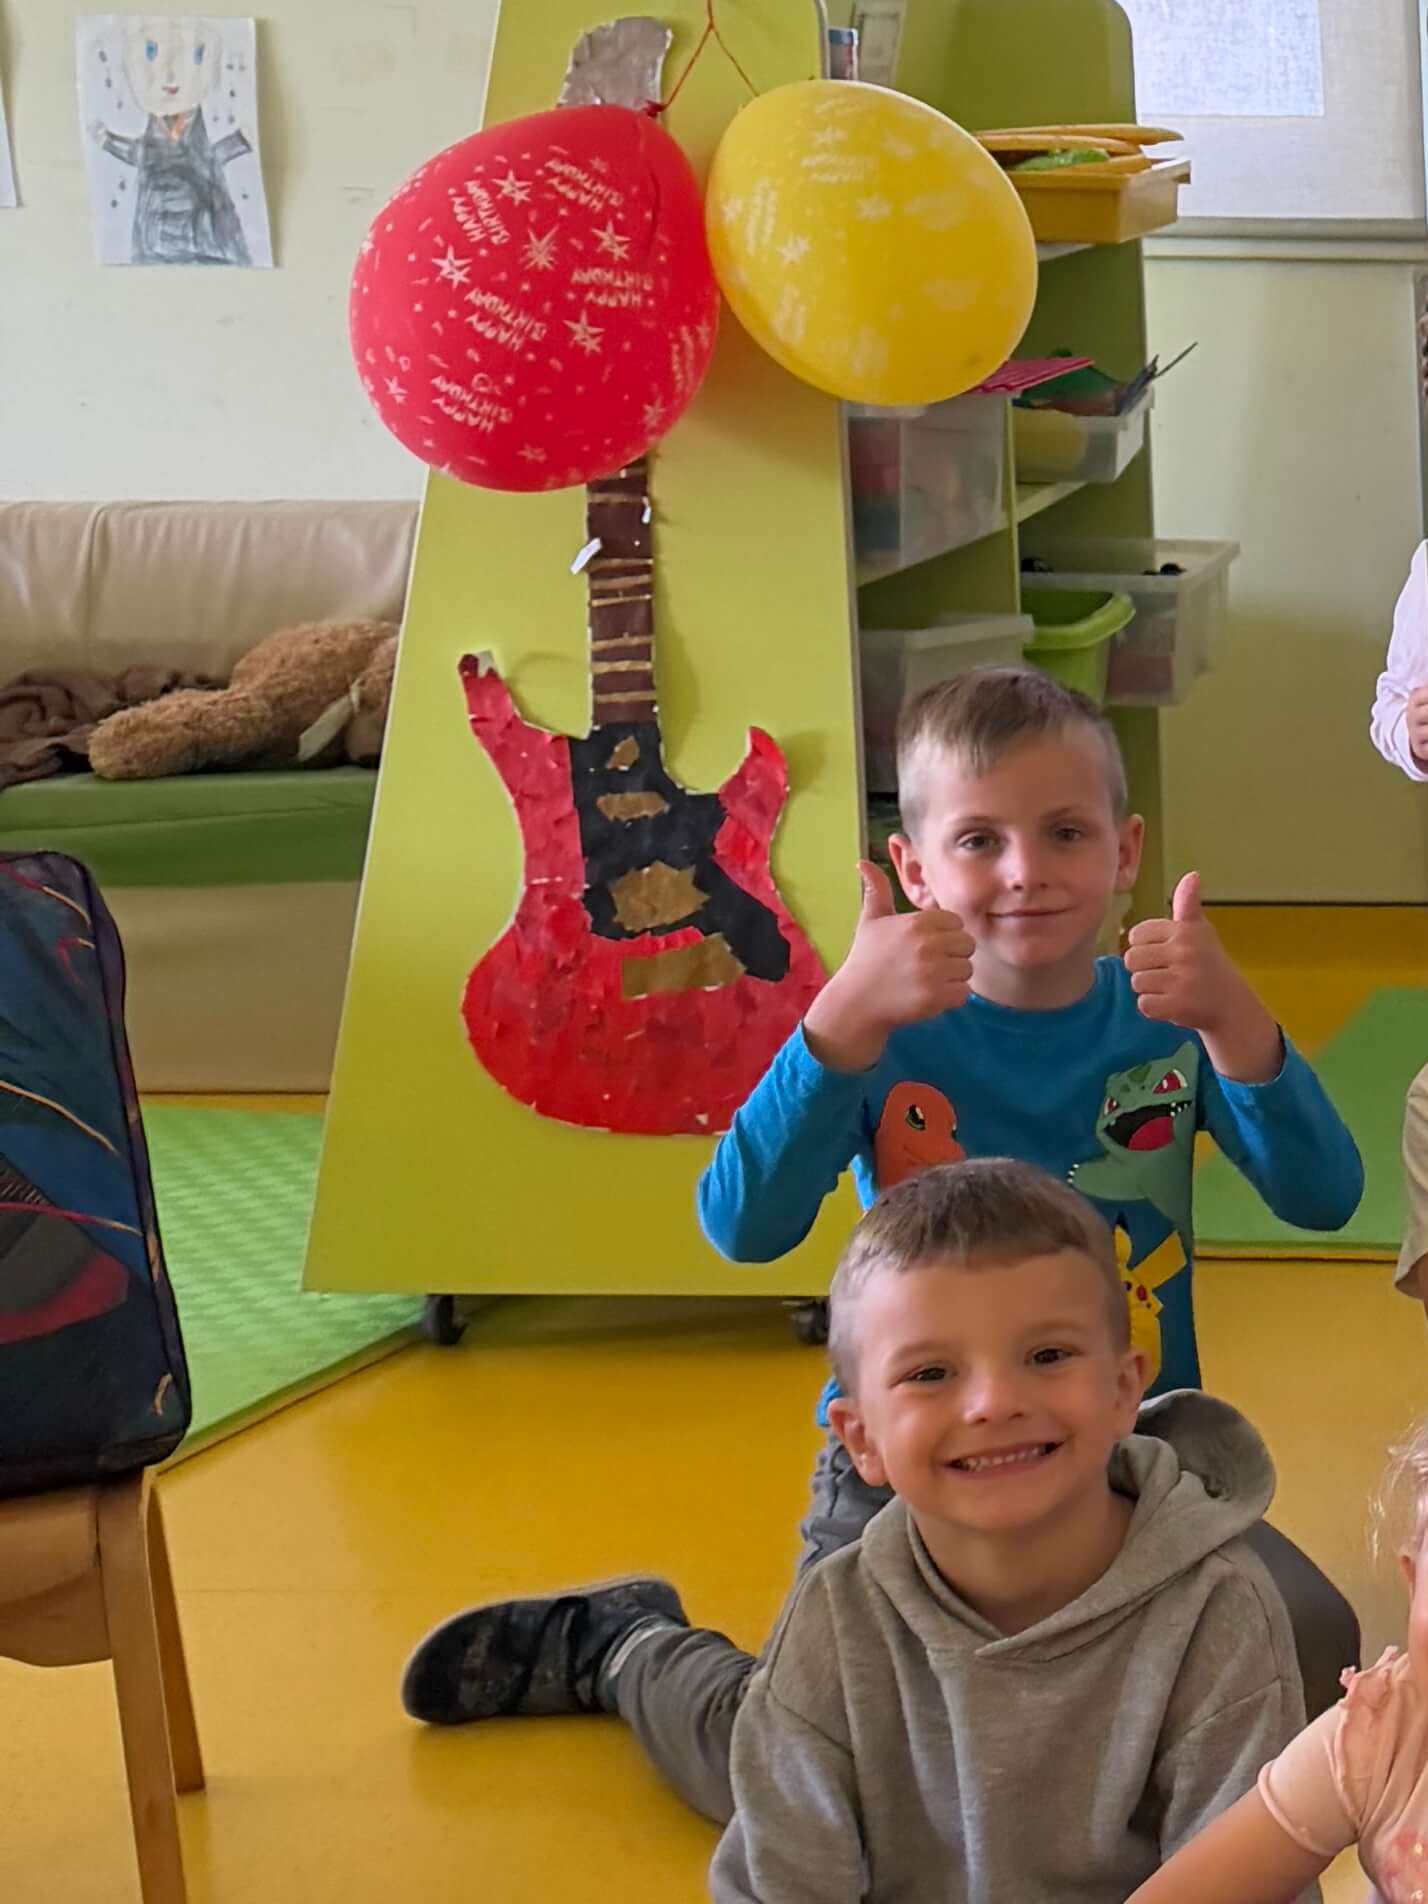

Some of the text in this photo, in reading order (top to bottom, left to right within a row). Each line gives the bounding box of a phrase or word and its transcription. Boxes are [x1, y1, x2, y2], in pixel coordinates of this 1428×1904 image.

[544, 156, 625, 208] BIRTHDAY
[546, 176, 602, 214] HAPPY
[451, 195, 488, 244] HAPPY
[464, 178, 511, 246] BIRTHDAY
[571, 266, 654, 292] BIRTHDAY
[584, 289, 642, 308] HAPPY
[464, 286, 548, 343] BIRTHDAY
[464, 312, 530, 352] HAPPY
[430, 374, 512, 424] BIRTHDAY
[431, 396, 496, 434] HAPPY
